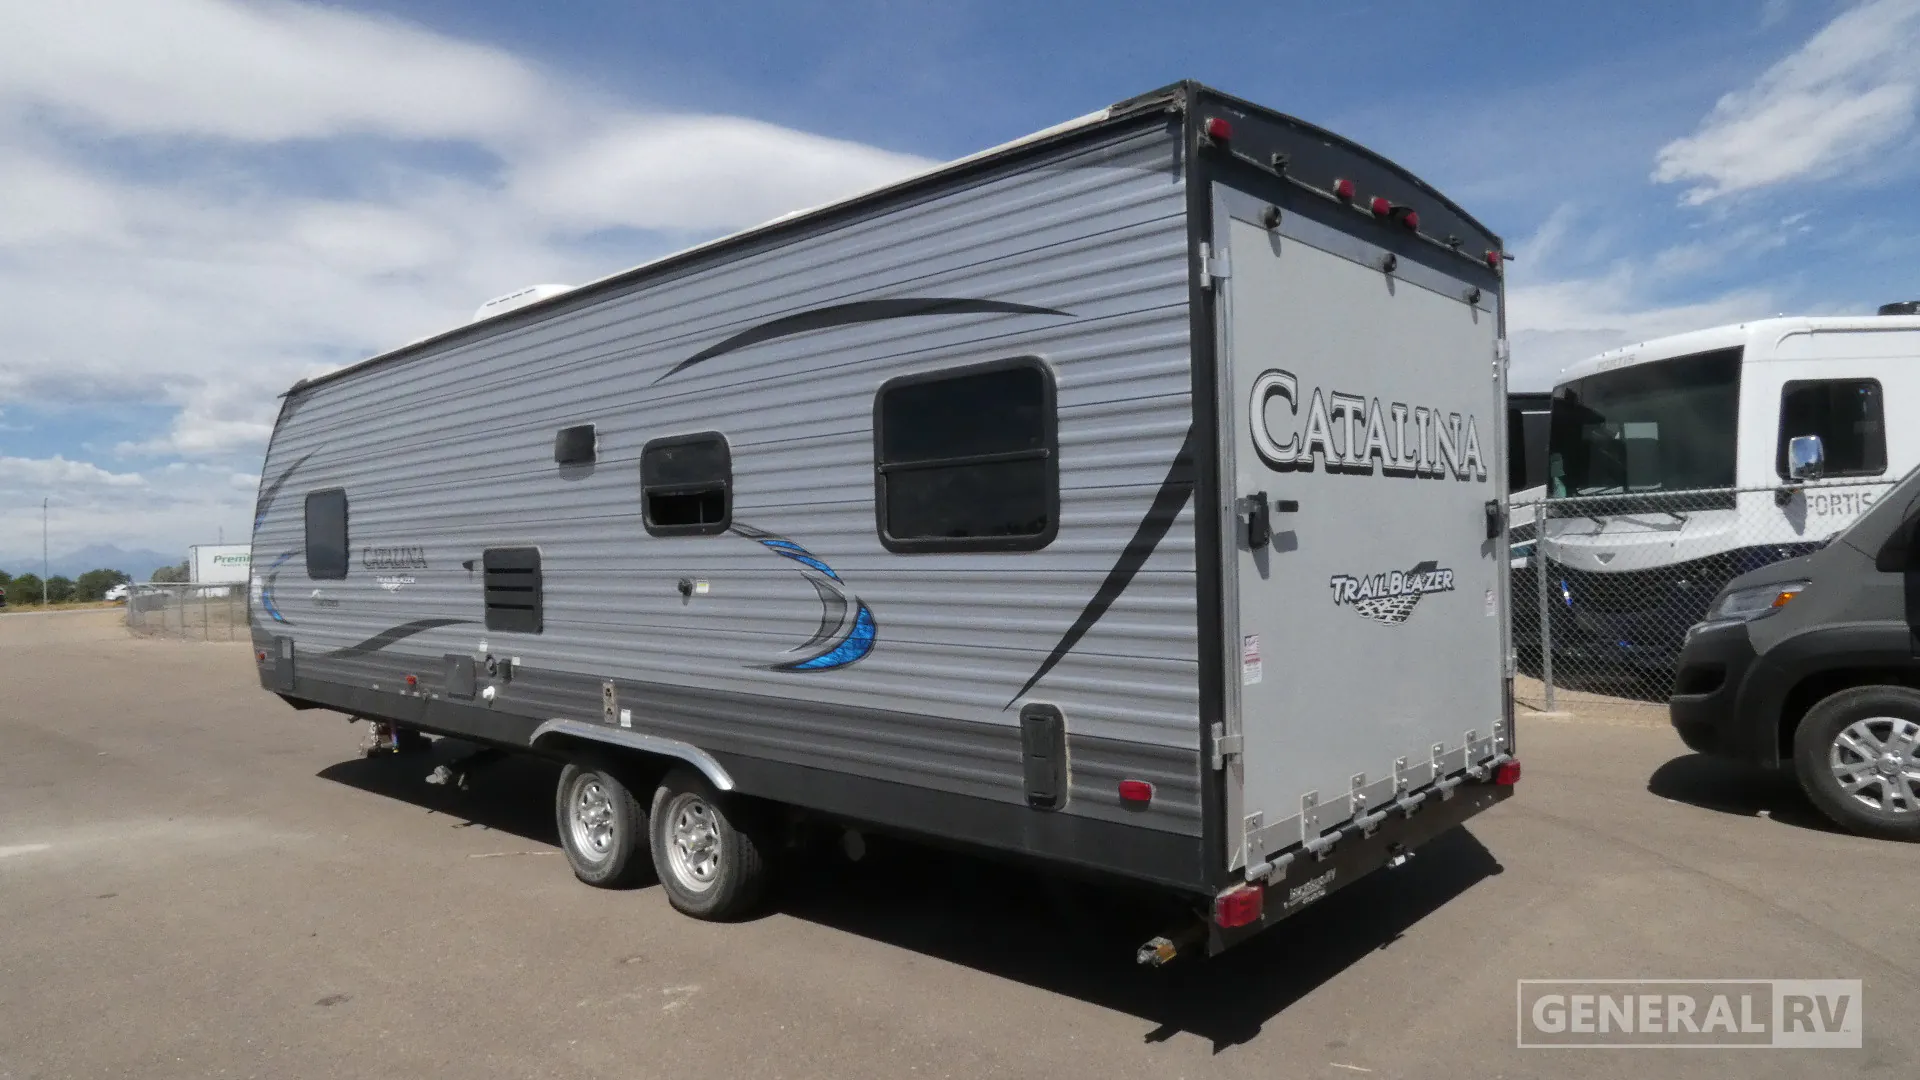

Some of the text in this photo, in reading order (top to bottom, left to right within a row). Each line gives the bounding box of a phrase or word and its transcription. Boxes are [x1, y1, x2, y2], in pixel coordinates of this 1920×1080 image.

[1249, 368, 1487, 483] CATALINA
[1807, 492, 1873, 516] FORTIS
[362, 546, 428, 569] CATALINA
